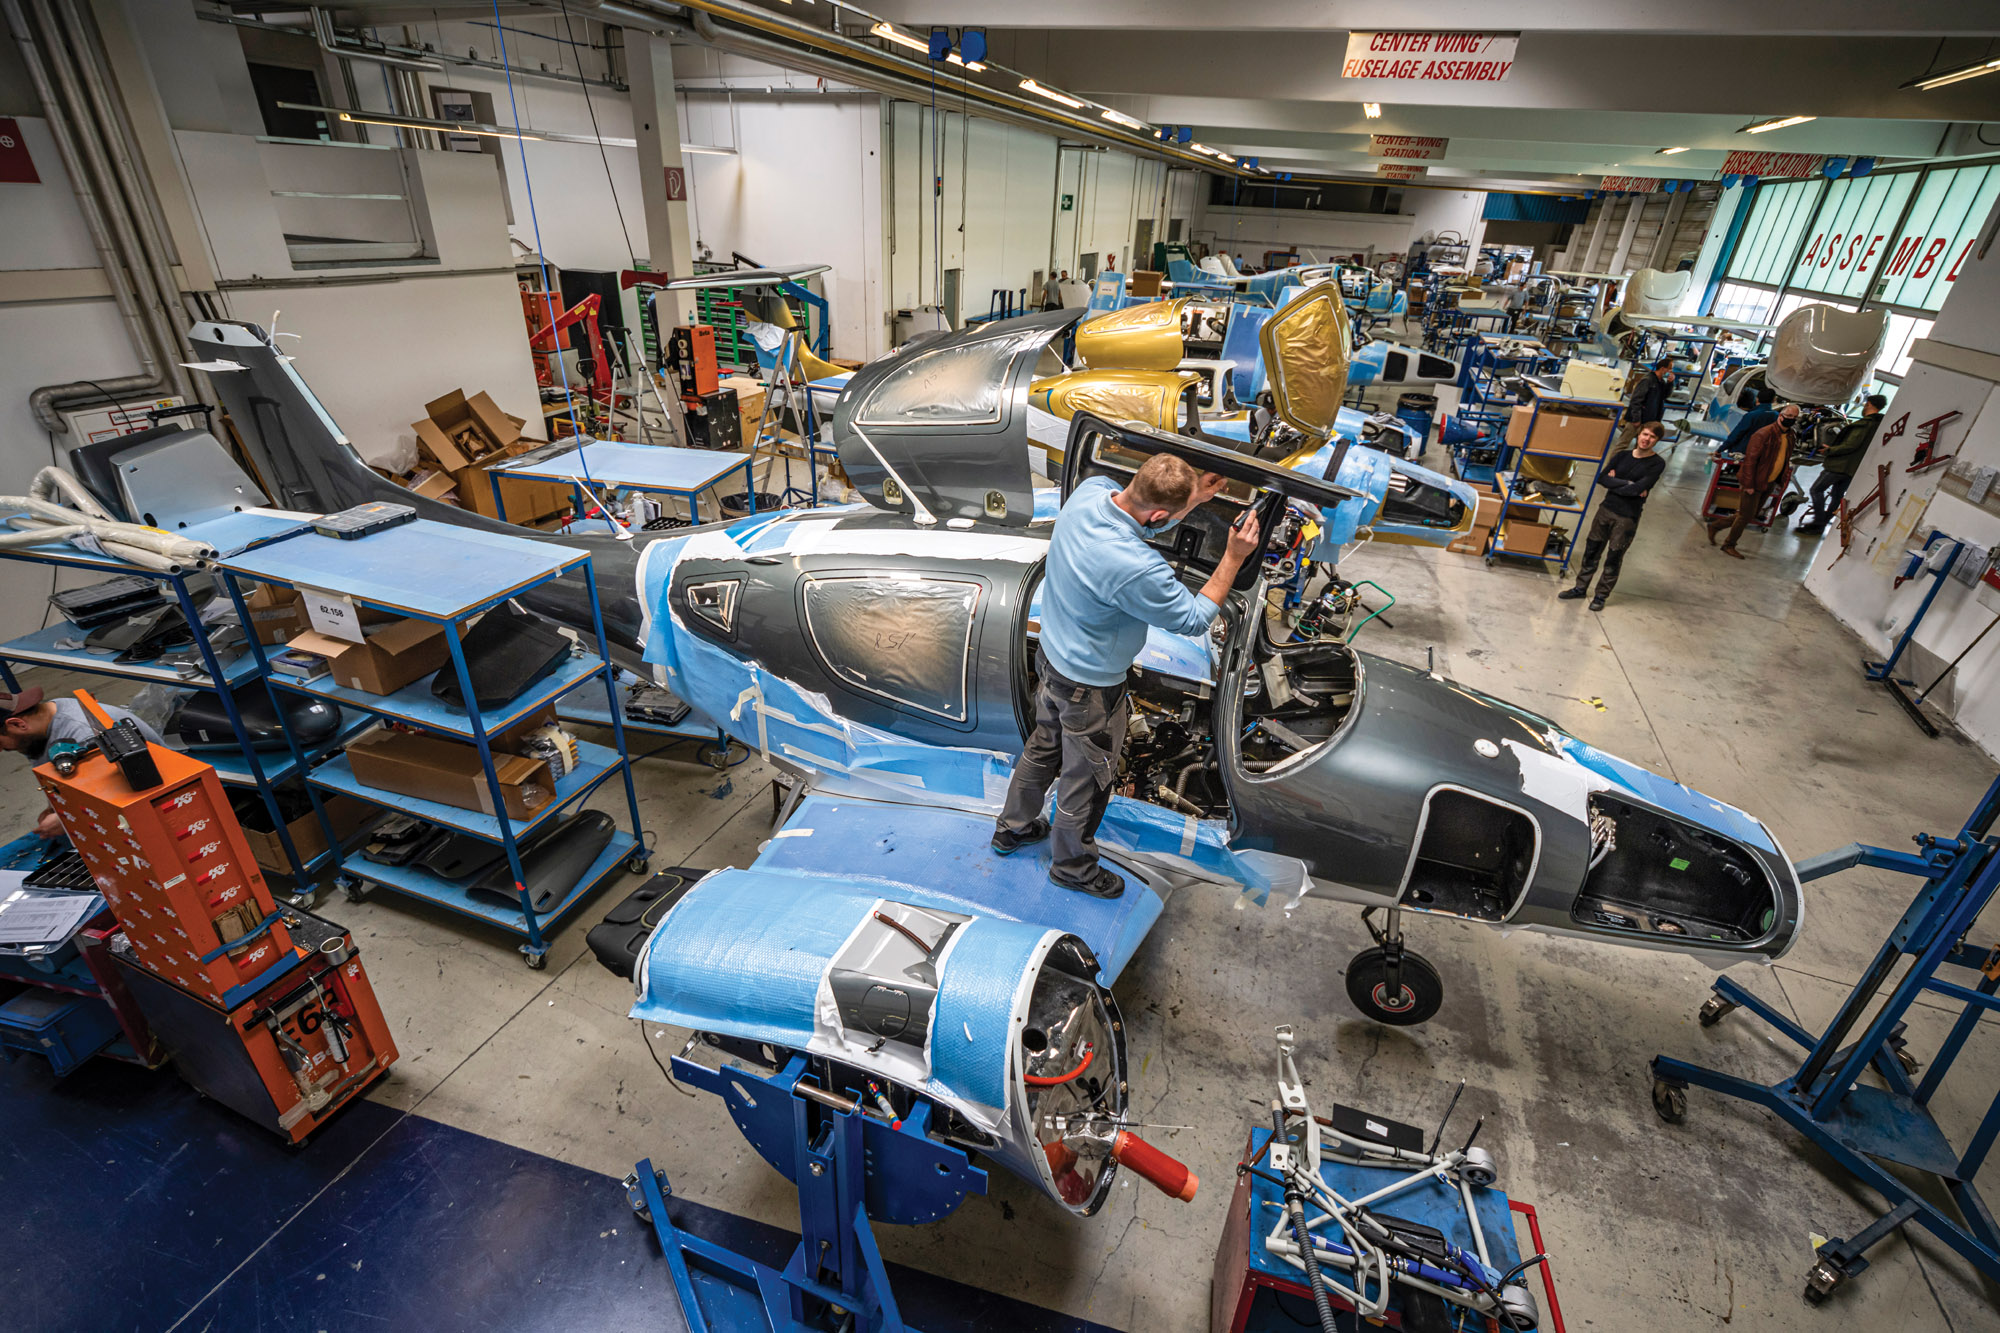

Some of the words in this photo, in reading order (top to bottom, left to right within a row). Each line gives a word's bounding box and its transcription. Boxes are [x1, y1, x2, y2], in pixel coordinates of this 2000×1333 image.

[1369, 32, 1433, 52] CENTER
[1434, 33, 1483, 53] WING
[1342, 59, 1422, 79] FUSELAGE
[1420, 60, 1513, 81] ASSEMBLY
[1383, 148, 1421, 158] STATION
[1422, 150, 1430, 159] 2
[1720, 150, 1777, 175] FUSELAGE
[320, 604, 344, 618] 62.158
